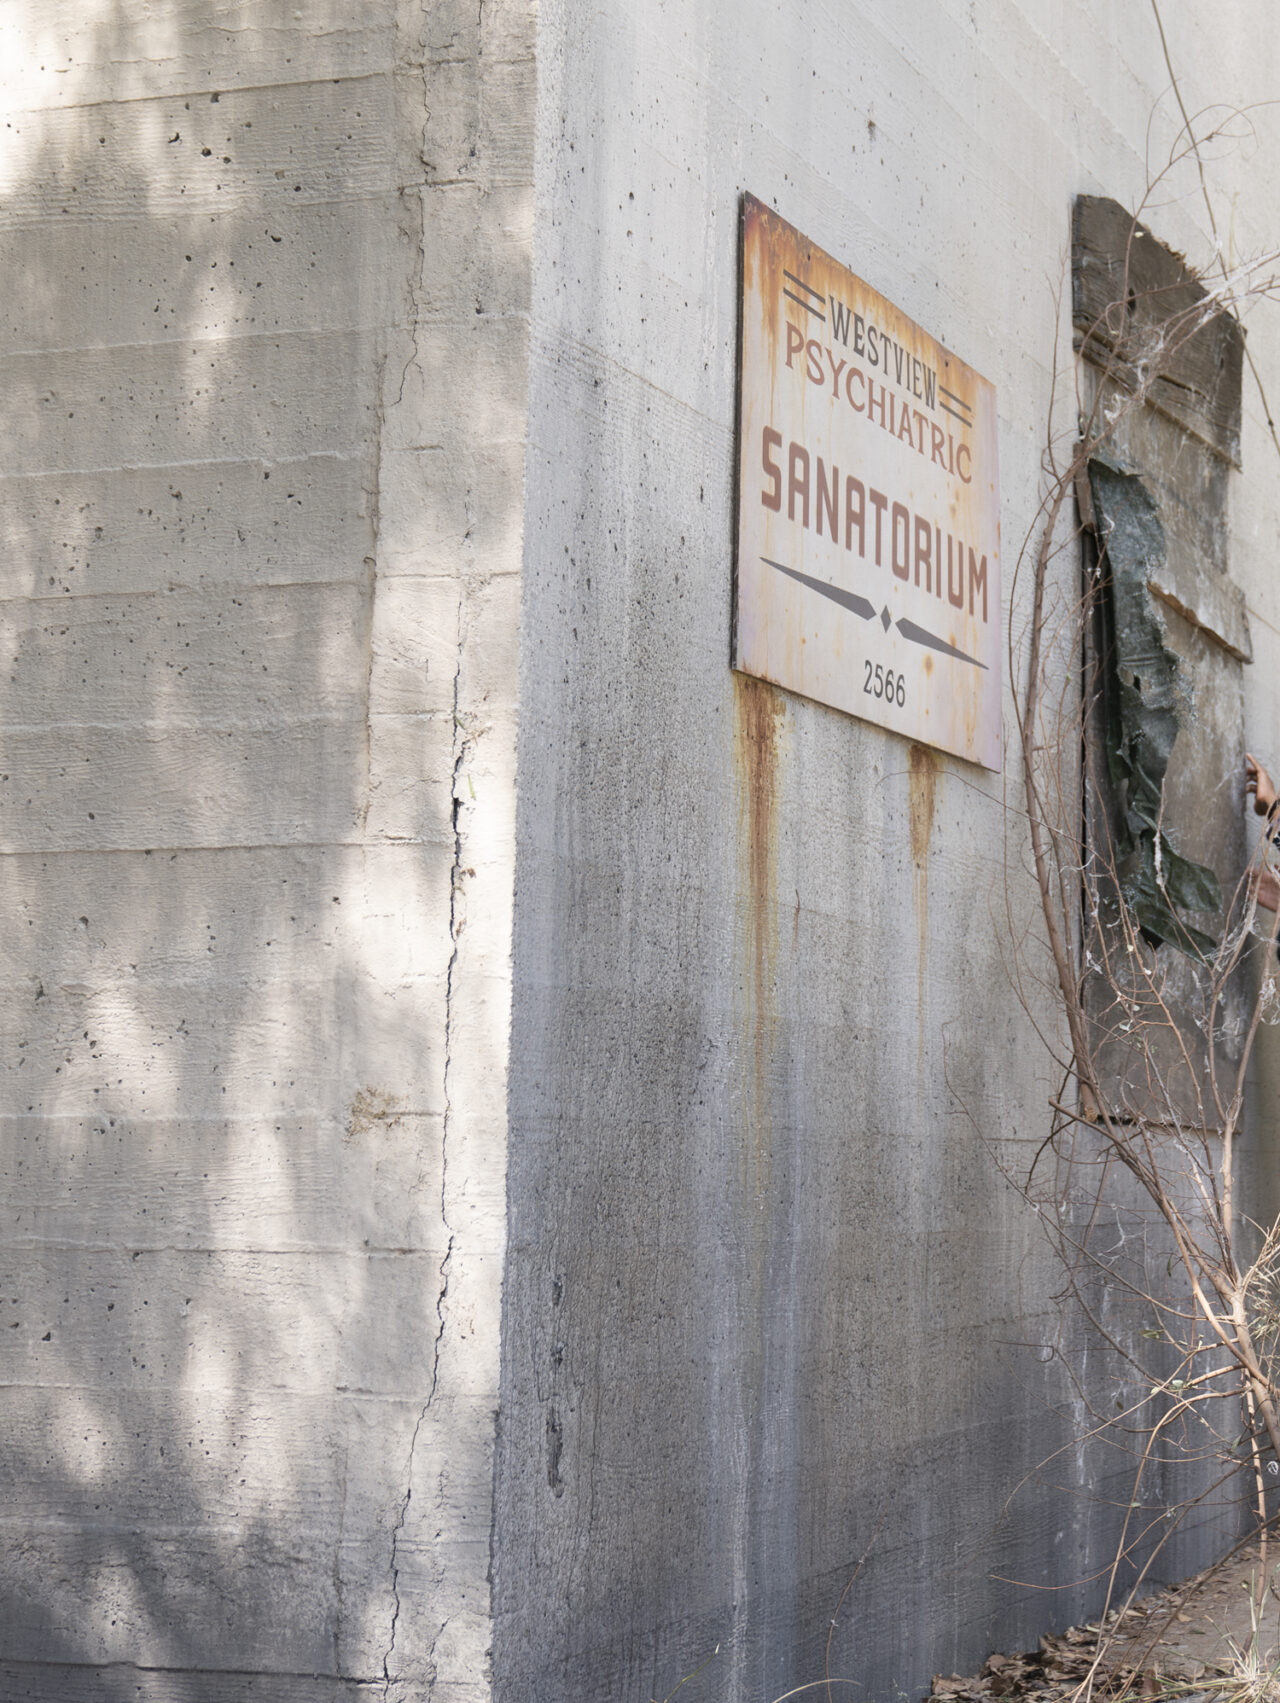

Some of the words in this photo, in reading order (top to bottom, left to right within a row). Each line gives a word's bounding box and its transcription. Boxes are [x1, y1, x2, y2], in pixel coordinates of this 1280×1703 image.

[785, 320, 972, 484] PSYCHIATRIC
[829, 294, 937, 411] WESTVIEW
[761, 425, 988, 624] SANATORIUM
[864, 659, 906, 708] 2566
